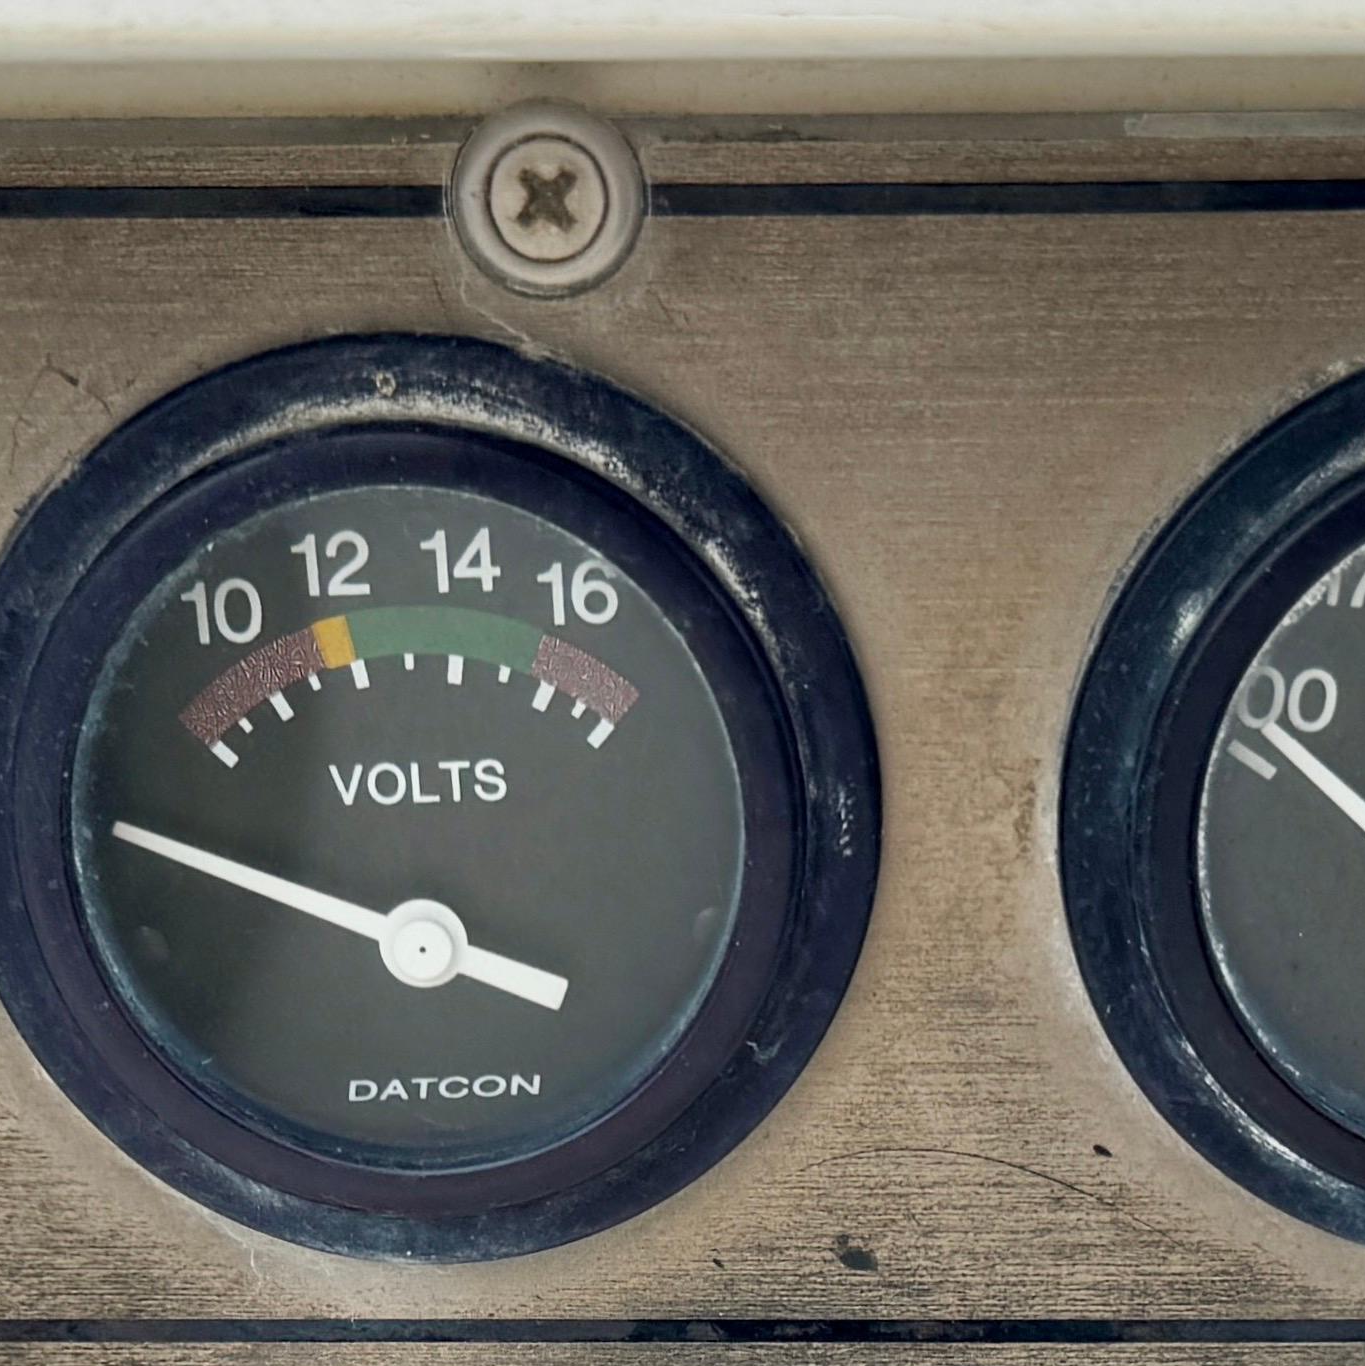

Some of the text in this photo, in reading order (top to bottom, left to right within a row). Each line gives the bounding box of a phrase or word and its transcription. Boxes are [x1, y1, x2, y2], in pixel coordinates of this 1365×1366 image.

[290, 530, 371, 597] 12
[419, 526, 501, 595] 14
[536, 560, 619, 626] 16
[180, 578, 263, 645] 10
[328, 759, 508, 806] VOLTS
[347, 1073, 541, 1101] DATCON
